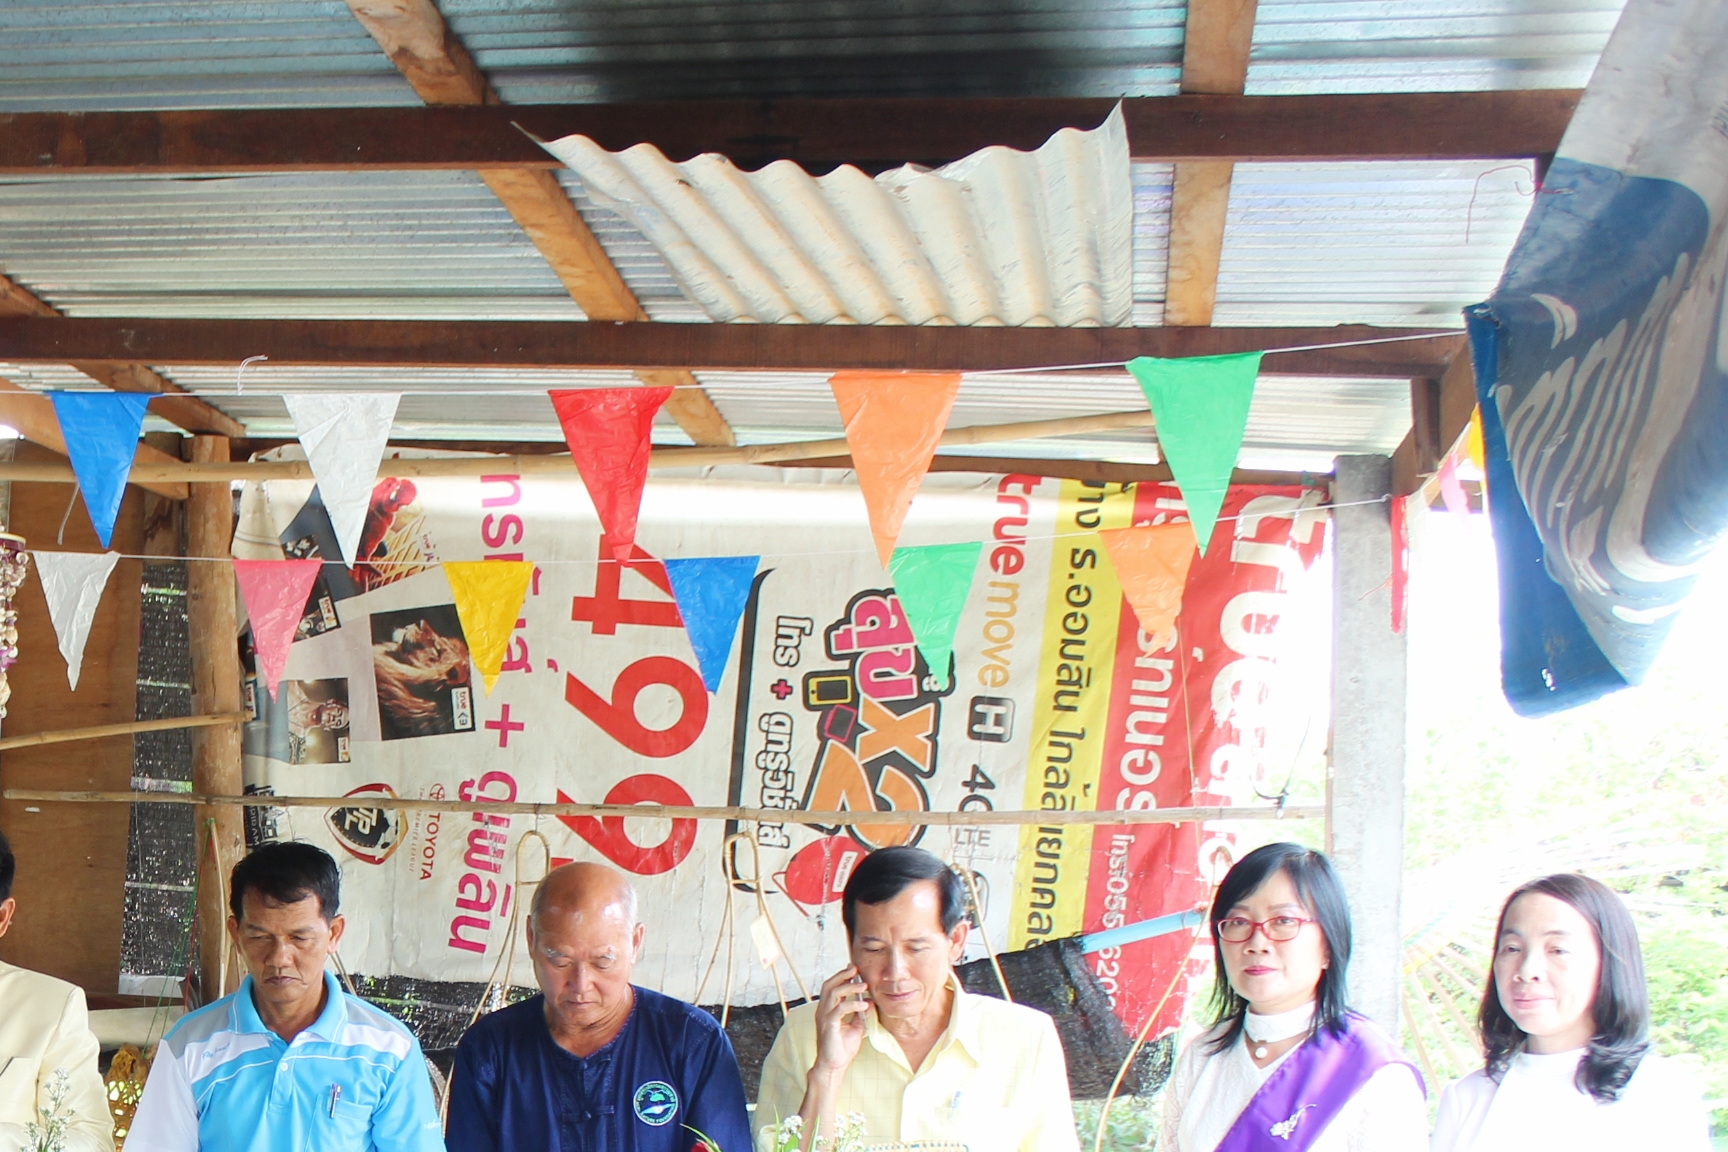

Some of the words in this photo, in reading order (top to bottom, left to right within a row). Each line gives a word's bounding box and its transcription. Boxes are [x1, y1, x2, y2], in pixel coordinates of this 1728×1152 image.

[988, 474, 1042, 576] true
[774, 616, 814, 667] โทร
[978, 582, 1019, 689] move
[419, 812, 441, 881] TOYOTA
